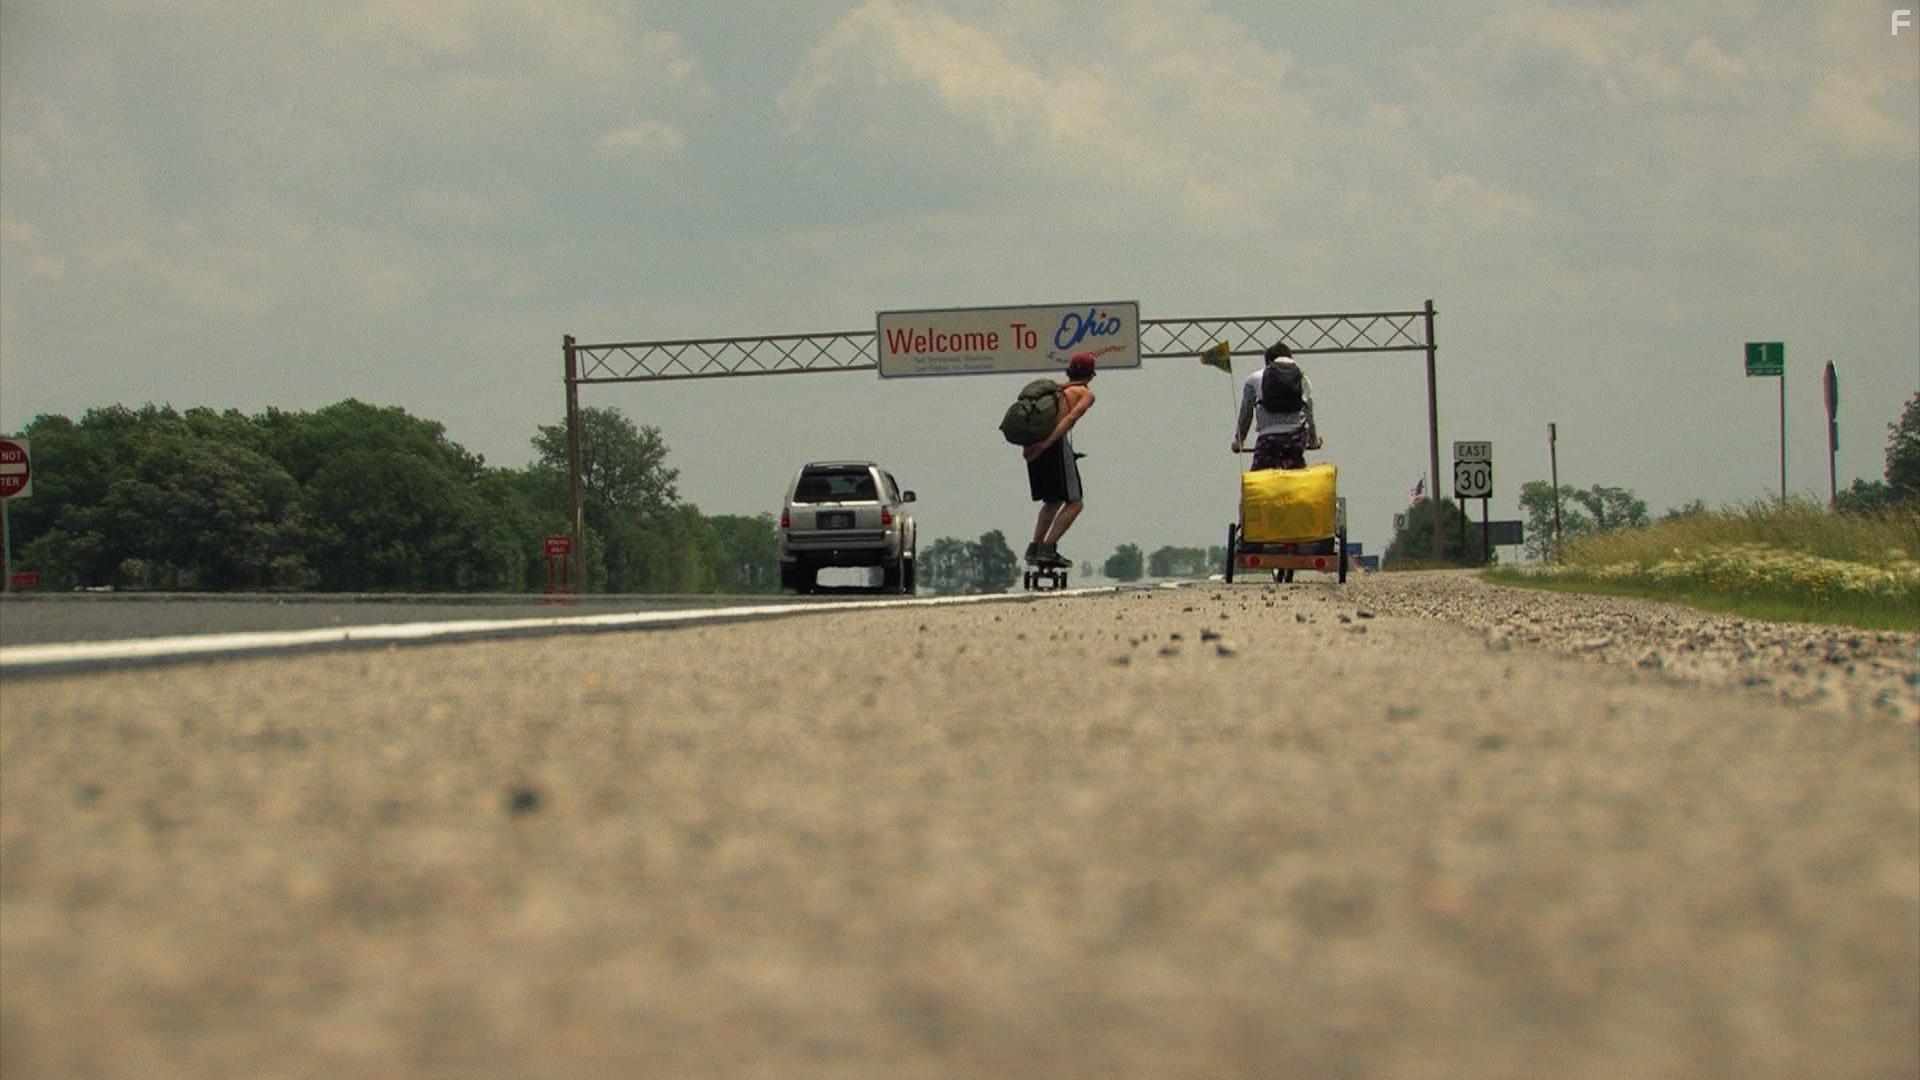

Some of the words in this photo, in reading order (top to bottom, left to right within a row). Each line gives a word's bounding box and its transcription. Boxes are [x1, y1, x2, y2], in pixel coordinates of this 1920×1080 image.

[887, 328, 999, 355] Welcome
[1010, 323, 1038, 350] To
[1054, 307, 1121, 351] Ohio
[1758, 344, 1767, 362] 1
[1, 450, 21, 461] NOT
[1458, 445, 1487, 457] EAST
[0, 476, 20, 487] TER
[1460, 469, 1486, 490] 30
